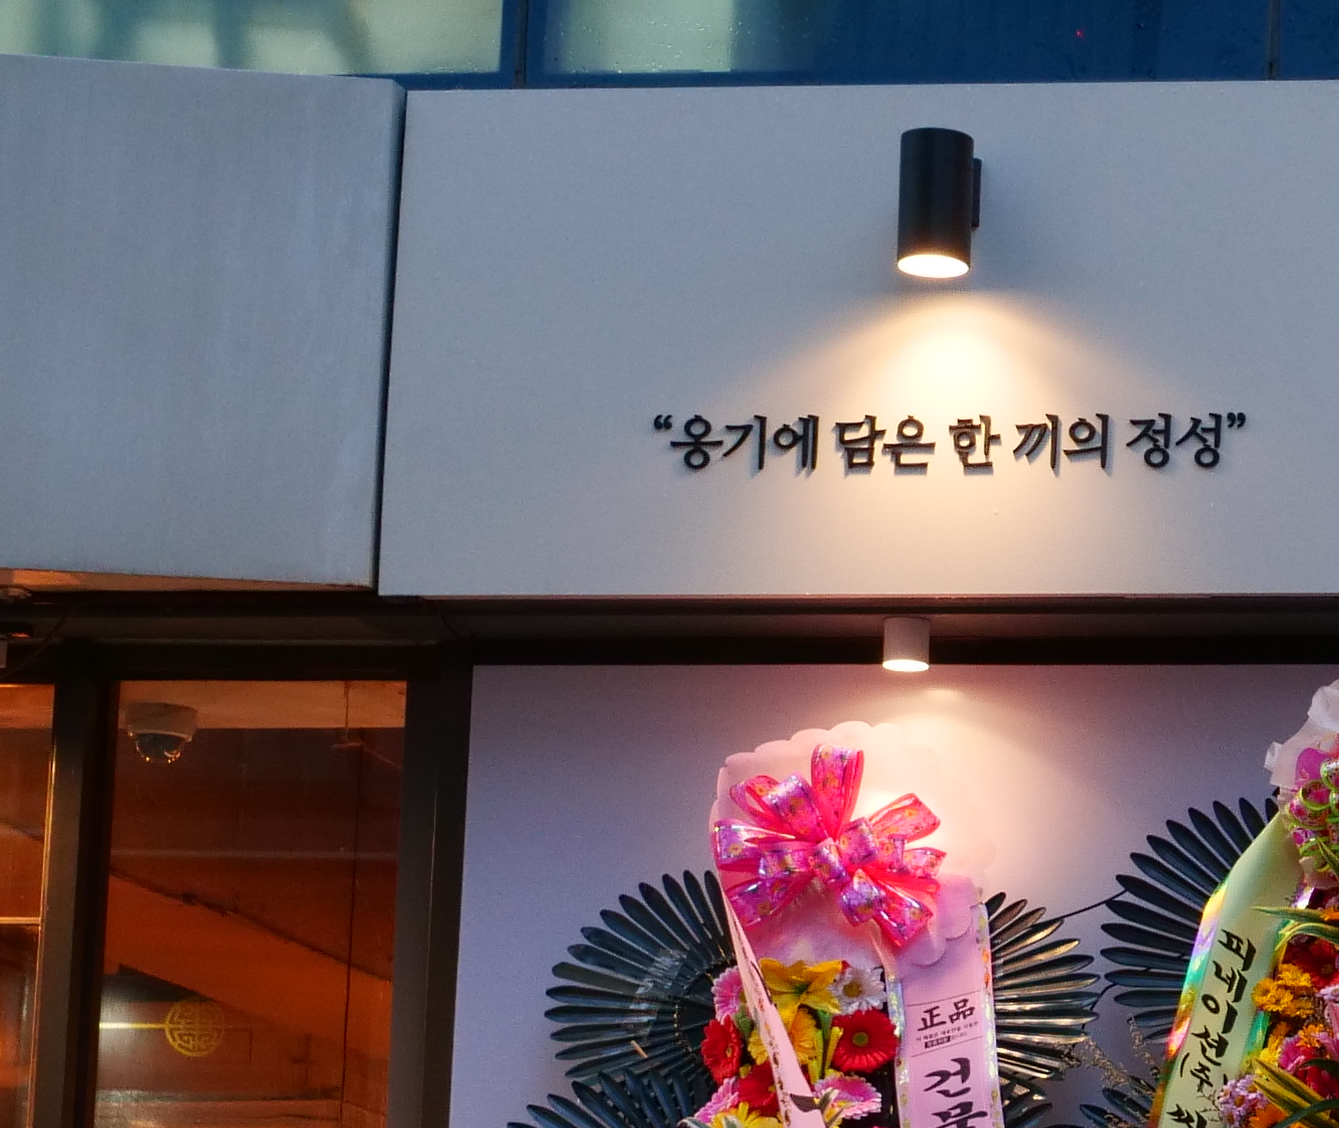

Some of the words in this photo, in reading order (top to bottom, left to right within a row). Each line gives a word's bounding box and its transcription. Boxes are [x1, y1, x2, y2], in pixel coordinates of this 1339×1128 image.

[835, 414, 936, 468] 담은
[948, 414, 1002, 468] 한
[1012, 413, 1111, 470] 끼의
[917, 998, 976, 1032] 正品
